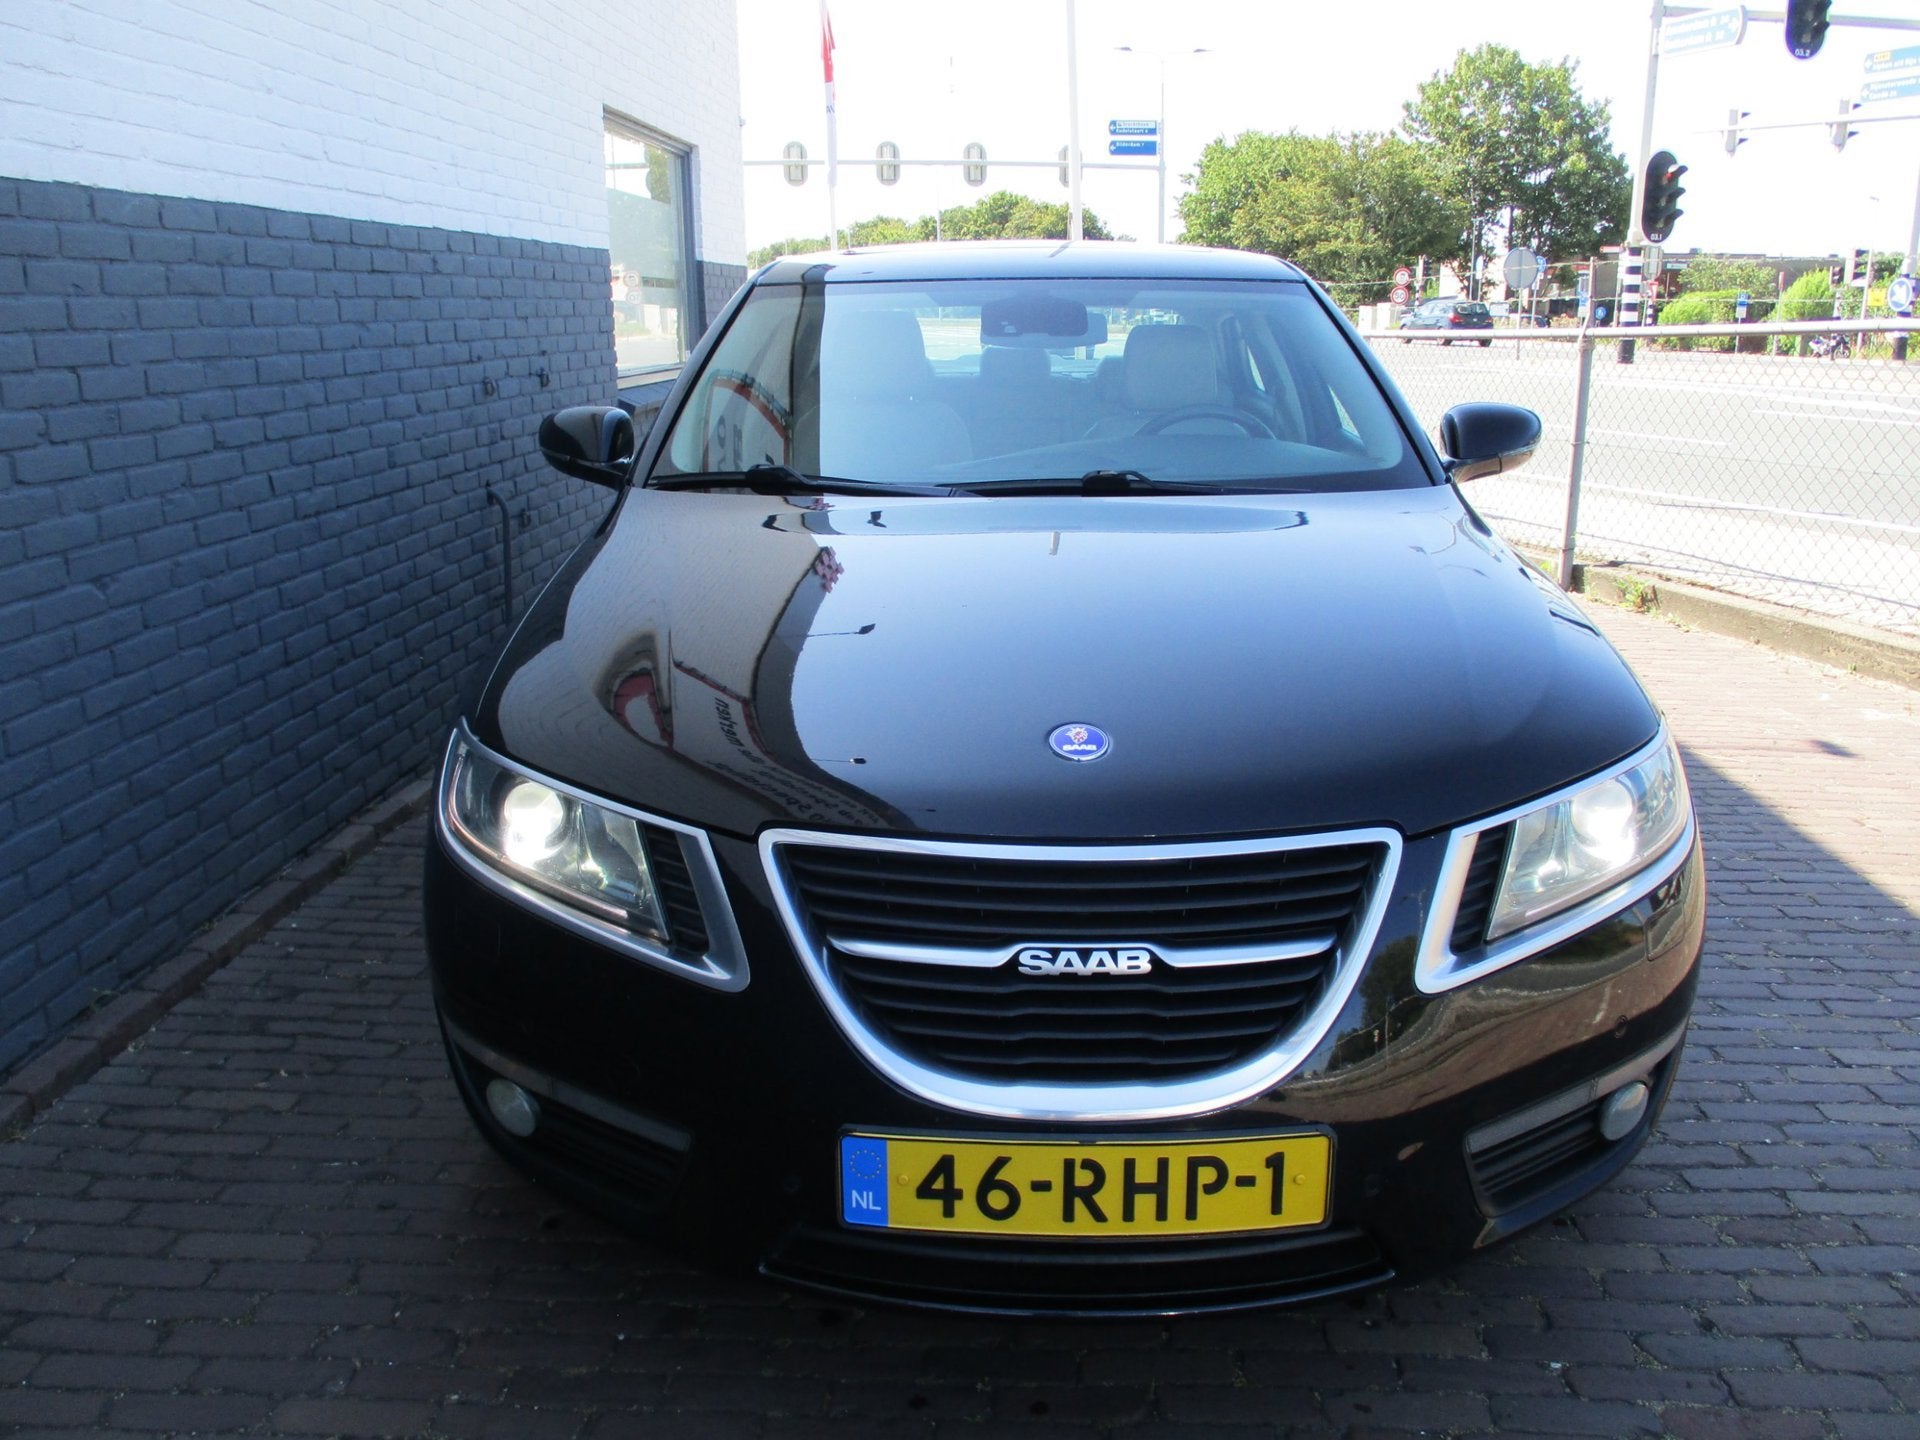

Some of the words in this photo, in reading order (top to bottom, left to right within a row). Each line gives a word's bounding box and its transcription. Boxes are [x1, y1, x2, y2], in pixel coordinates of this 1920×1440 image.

[1795, 48, 1810, 57] 03.2
[1650, 233, 1662, 241] 03.1
[1018, 949, 1152, 976] SAAB
[852, 1190, 882, 1211] NL
[915, 1151, 1284, 1223] 46-RHP-1
